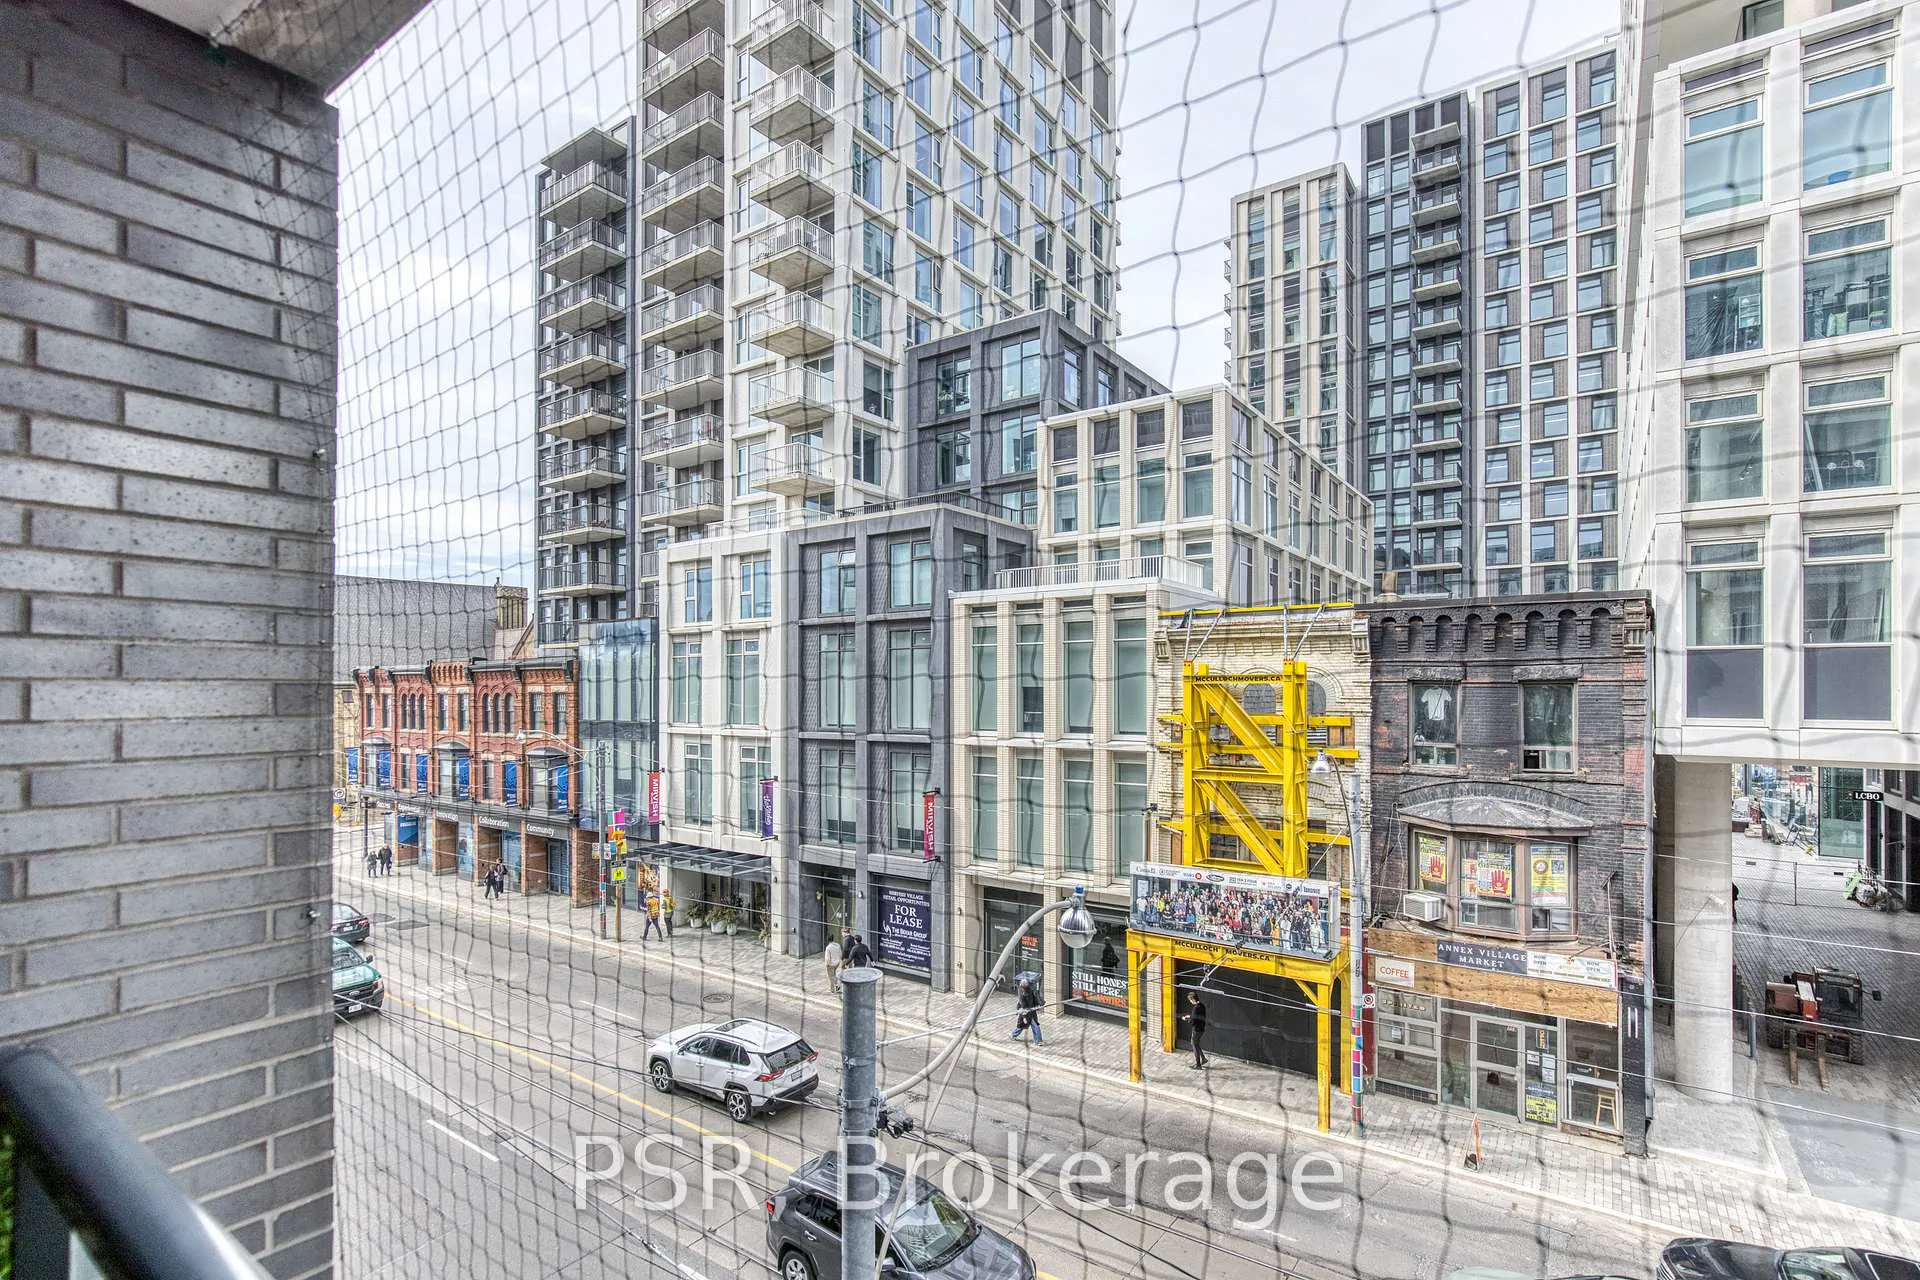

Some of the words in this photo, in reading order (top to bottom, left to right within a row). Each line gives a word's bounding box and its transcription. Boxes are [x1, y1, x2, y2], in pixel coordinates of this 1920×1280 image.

[1855, 792, 1880, 800] LCBO
[478, 815, 510, 828] Collaboration
[526, 823, 556, 837] Community
[894, 904, 917, 917] FOR
[889, 913, 923, 929] LEASE
[1175, 940, 1219, 952] MCCULLOCH
[1225, 948, 1270, 961] MOVERS.CA
[1438, 943, 1474, 954] ANNEX
[1478, 949, 1528, 962] VILLAGE
[1459, 956, 1505, 968] MARKET
[1379, 966, 1409, 979] COFFEE
[1072, 970, 1096, 983] STILL
[1097, 975, 1128, 990] HONES
[1072, 980, 1096, 993] STILL
